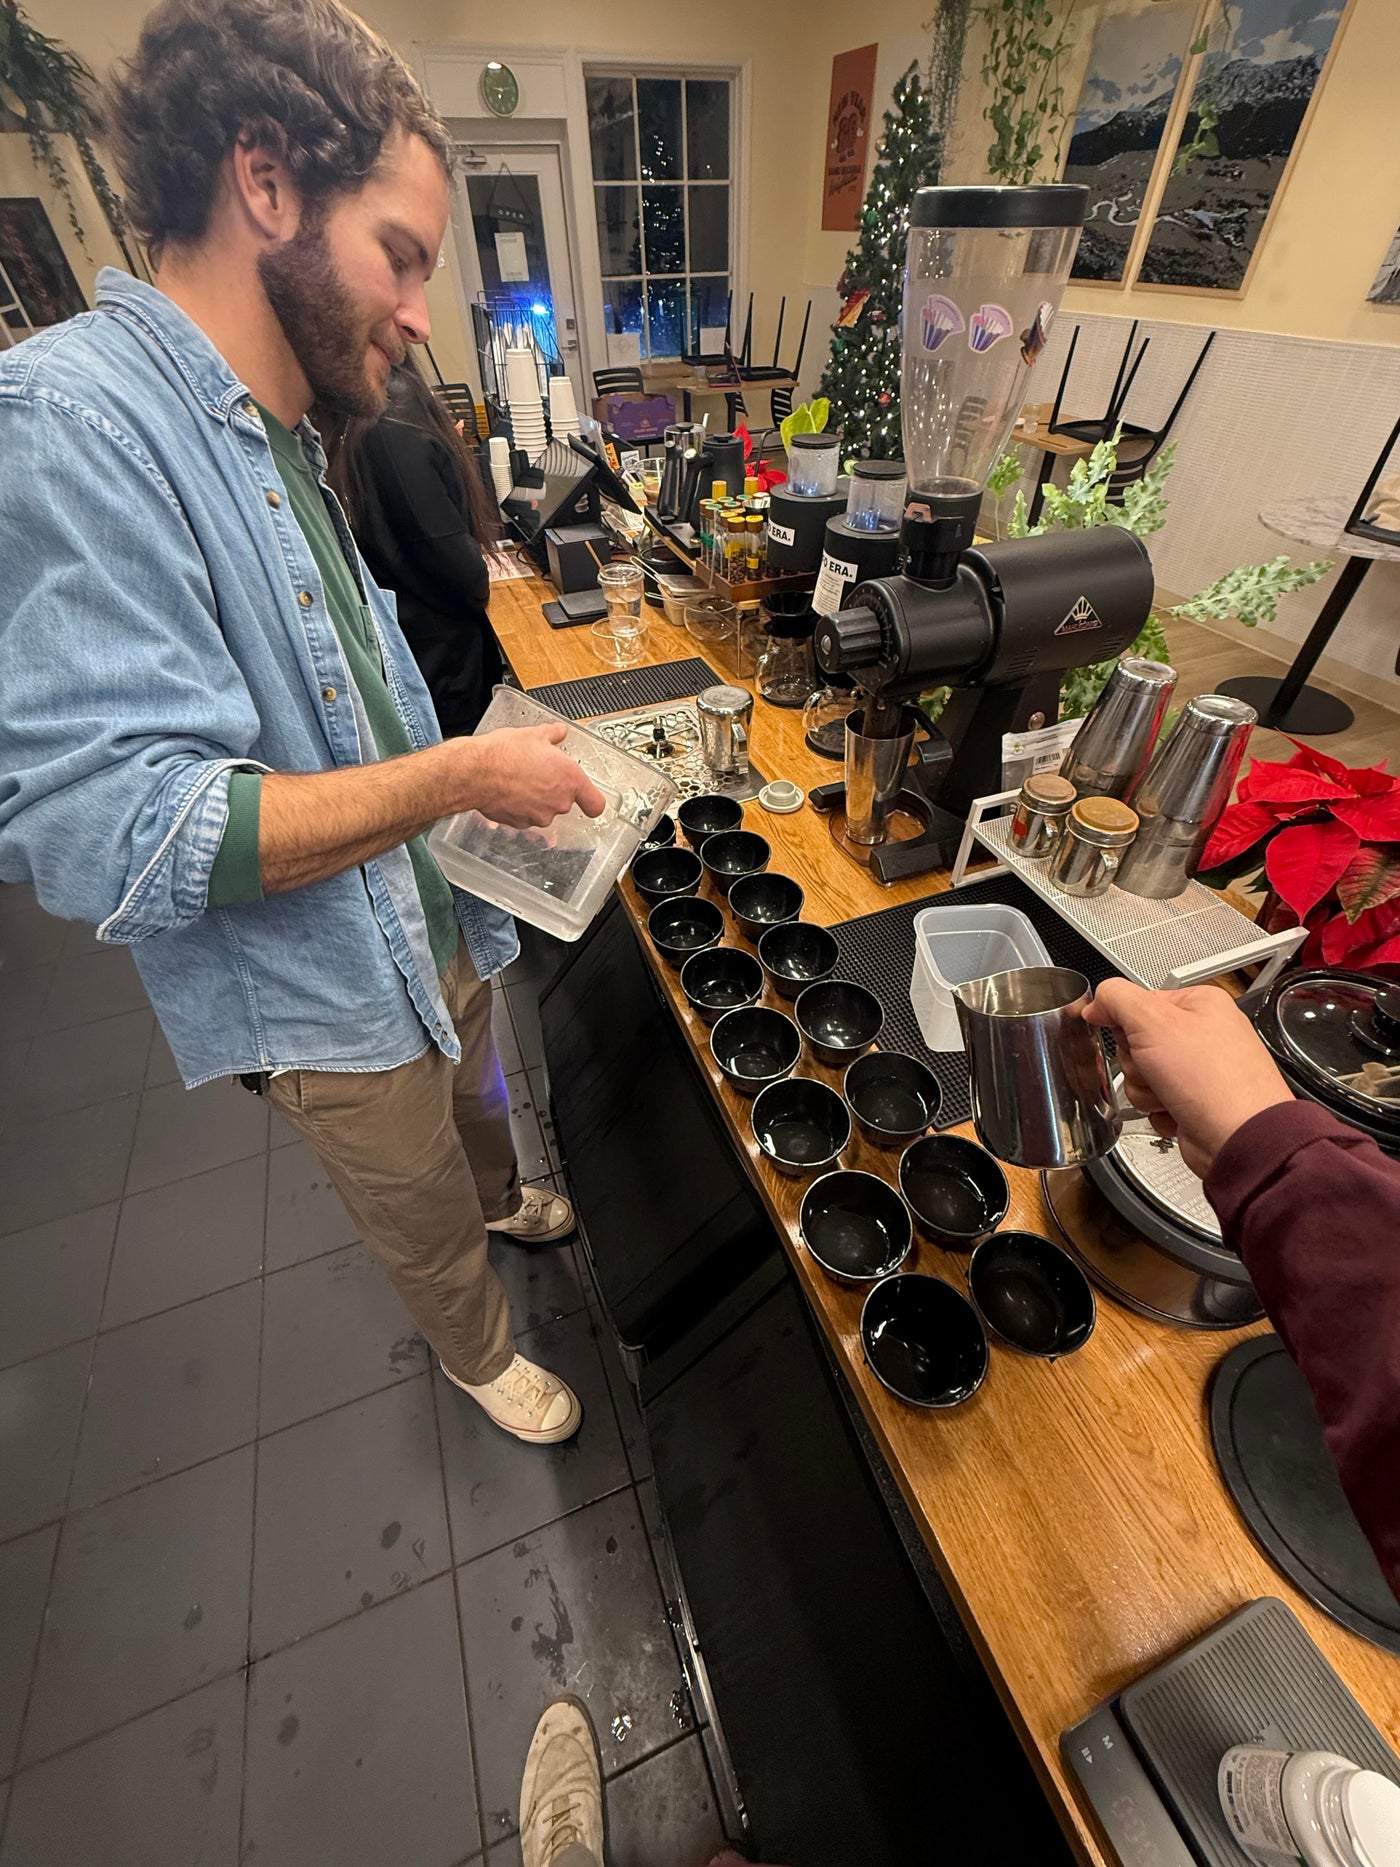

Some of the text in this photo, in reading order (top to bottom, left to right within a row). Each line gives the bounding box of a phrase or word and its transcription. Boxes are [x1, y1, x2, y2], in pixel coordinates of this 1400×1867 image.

[498, 209, 524, 220] OPEN
[772, 526, 791, 541] ERA.
[829, 561, 853, 578] ERA.
[1102, 1735, 1114, 1749] M
